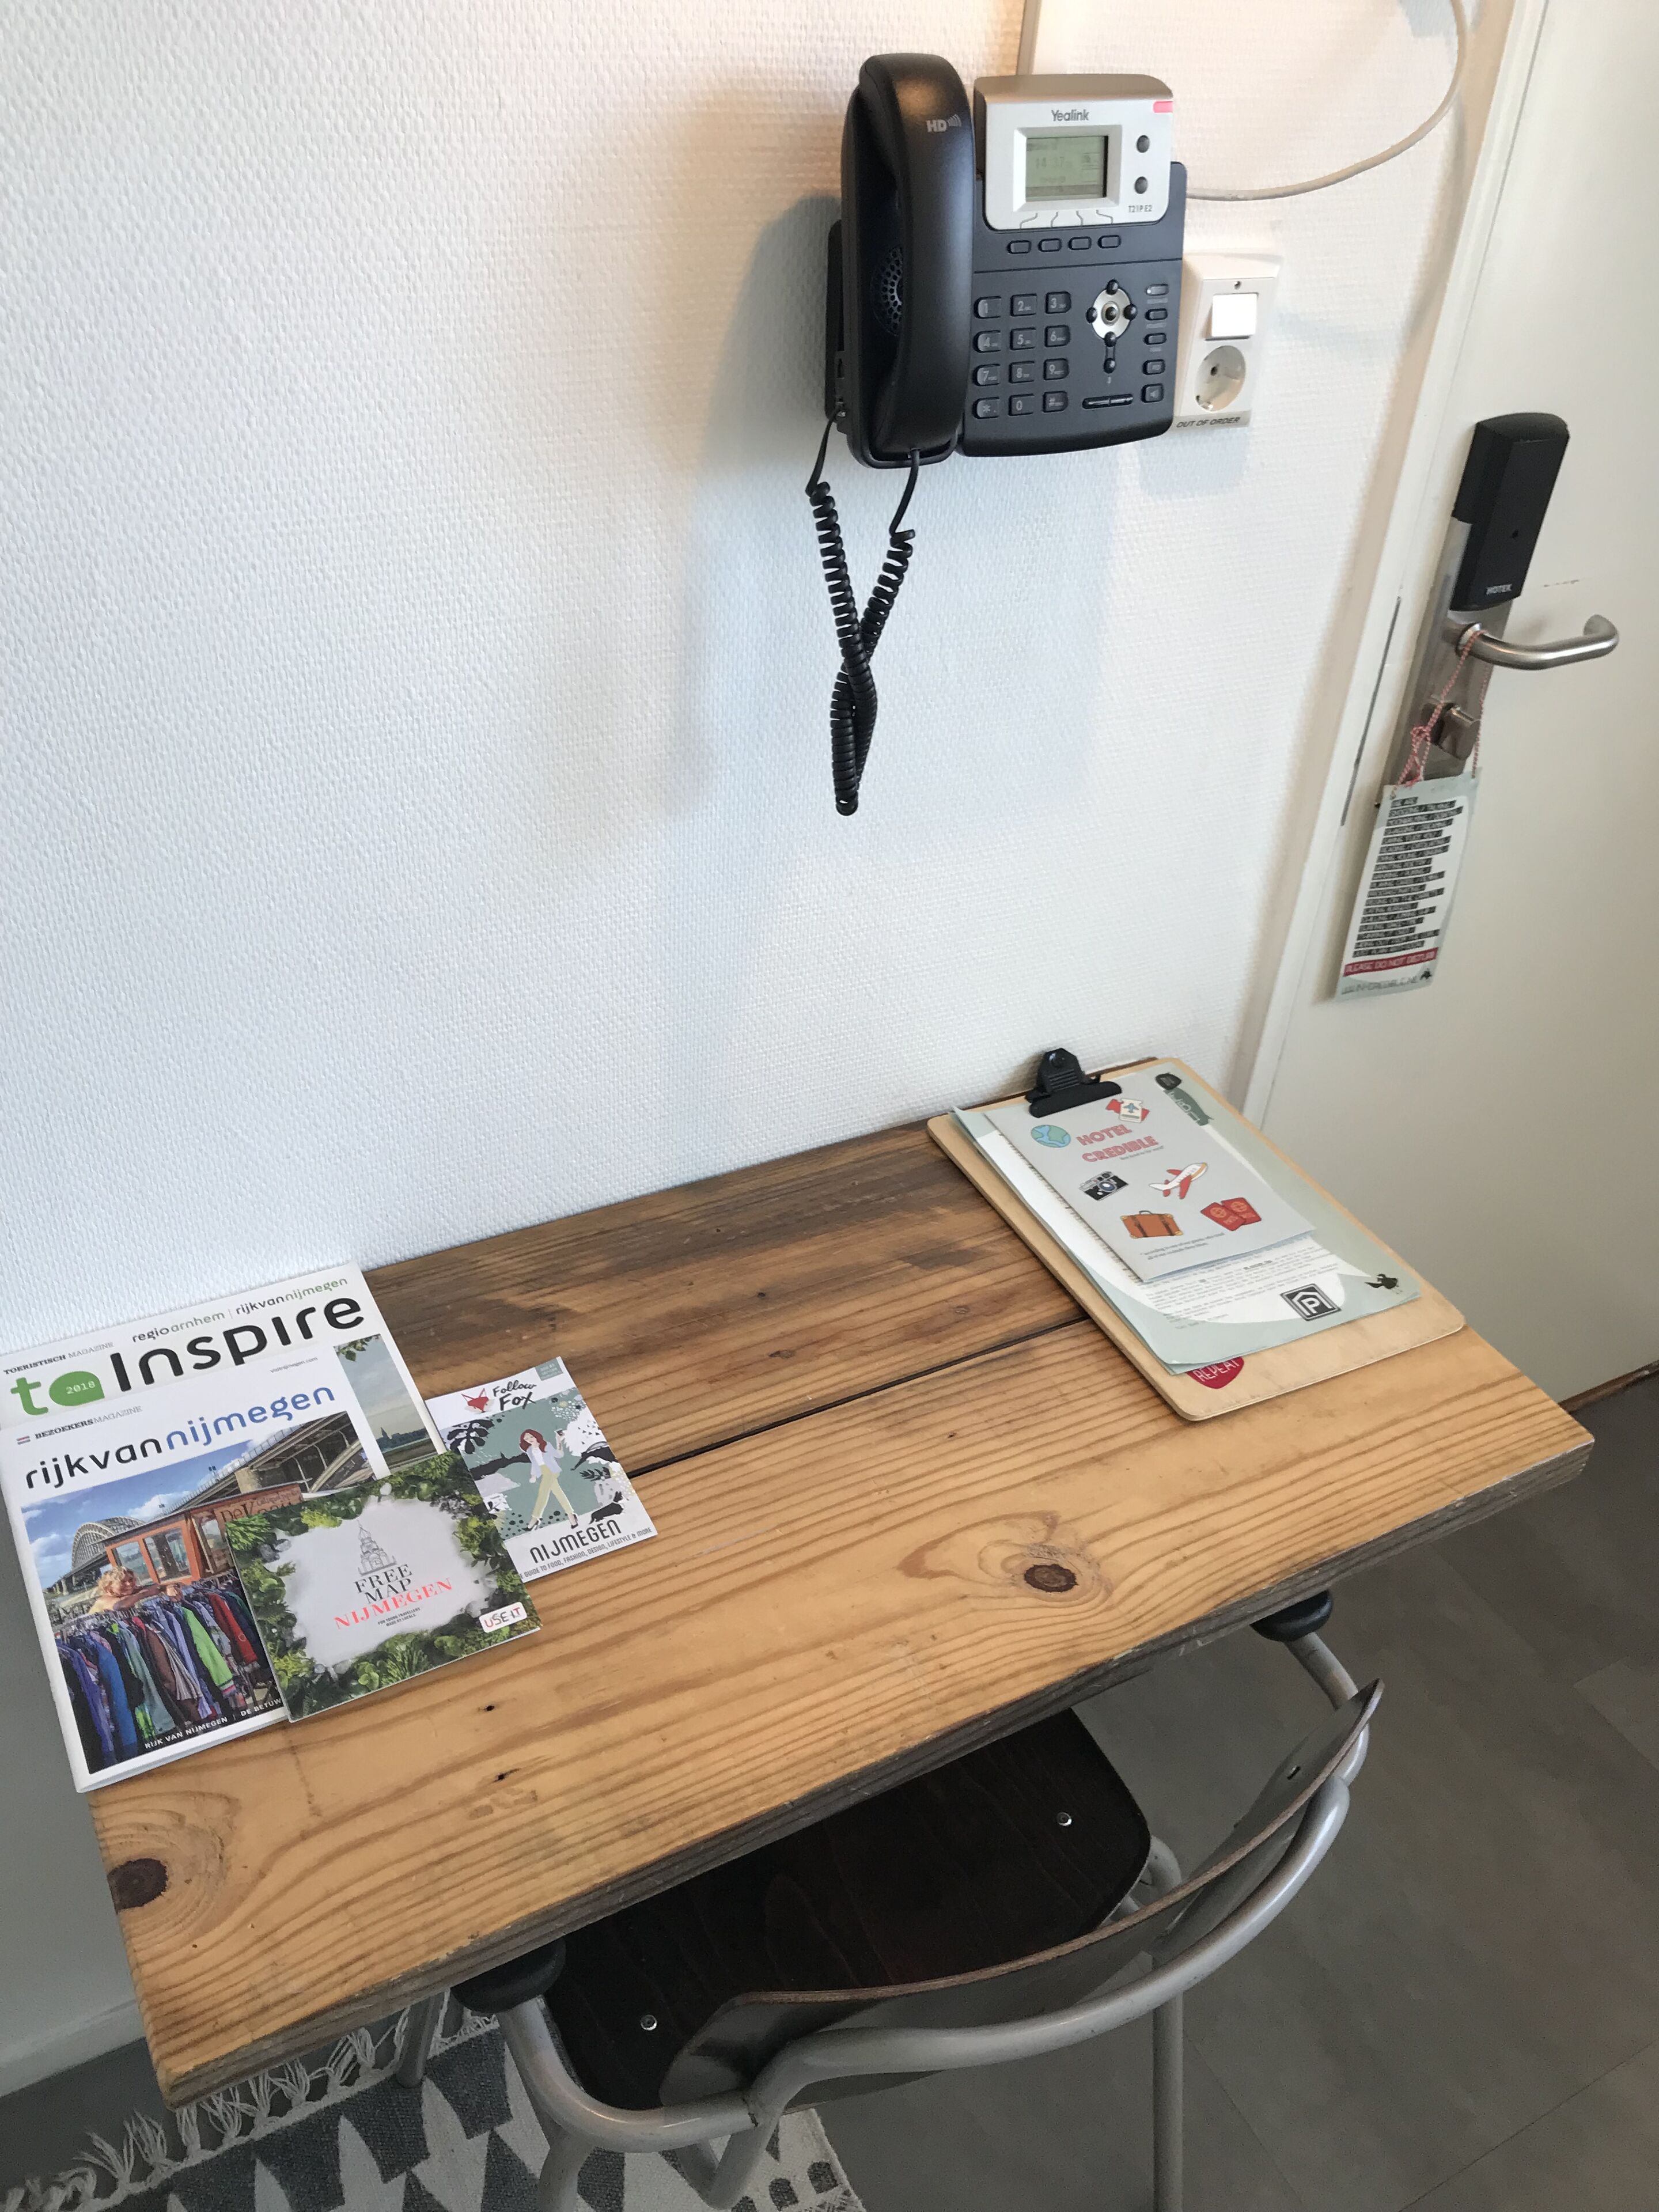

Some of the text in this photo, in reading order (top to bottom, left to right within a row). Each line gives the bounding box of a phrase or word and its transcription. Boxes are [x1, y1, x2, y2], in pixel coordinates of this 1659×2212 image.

[1051, 109, 1089, 122] Yealink
[925, 119, 946, 132] HD
[983, 303, 988, 314] 1
[1017, 301, 1024, 312] 2
[1050, 298, 1057, 308] 3
[983, 337, 990, 347] 4
[1017, 334, 1024, 345] 5
[1050, 331, 1056, 342] 6
[983, 370, 989, 381] 7
[1017, 368, 1022, 378] 8
[1049, 364, 1055, 374] 9
[1210, 416, 1241, 425] ORDER
[1374, 961, 1386, 969] DO
[1388, 957, 1406, 967] NOT
[1076, 1124, 1132, 1146] HOTEL
[1082, 1135, 1158, 1162] CREDIBLE
[236, 1277, 348, 1316] rijkvannijmegen
[3, 1342, 114, 1374] TOERISTISCH MAGAZINE
[66, 1381, 96, 1395] 2018
[493, 1380, 537, 1397] Follow
[25, 1387, 335, 1488] rijkvannijmegen
[530, 1520, 622, 1563] NIJMEGEN
[524, 1567, 540, 1578] GUIDE
[547, 1560, 564, 1569] FOOD,
[563, 1551, 588, 1563] FASHION,
[587, 1543, 608, 1555] DESIGN,
[607, 1535, 632, 1548] LIFESTYLE
[636, 1527, 652, 1537] MORE
[354, 1564, 412, 1593] FREE
[364, 1578, 411, 1604] MAP
[334, 1578, 452, 1629] NIJMEGEN
[484, 1607, 520, 1627] USE IT
[145, 1698, 282, 1749] RIJK VAN NIJMEGEN DE BETUW
